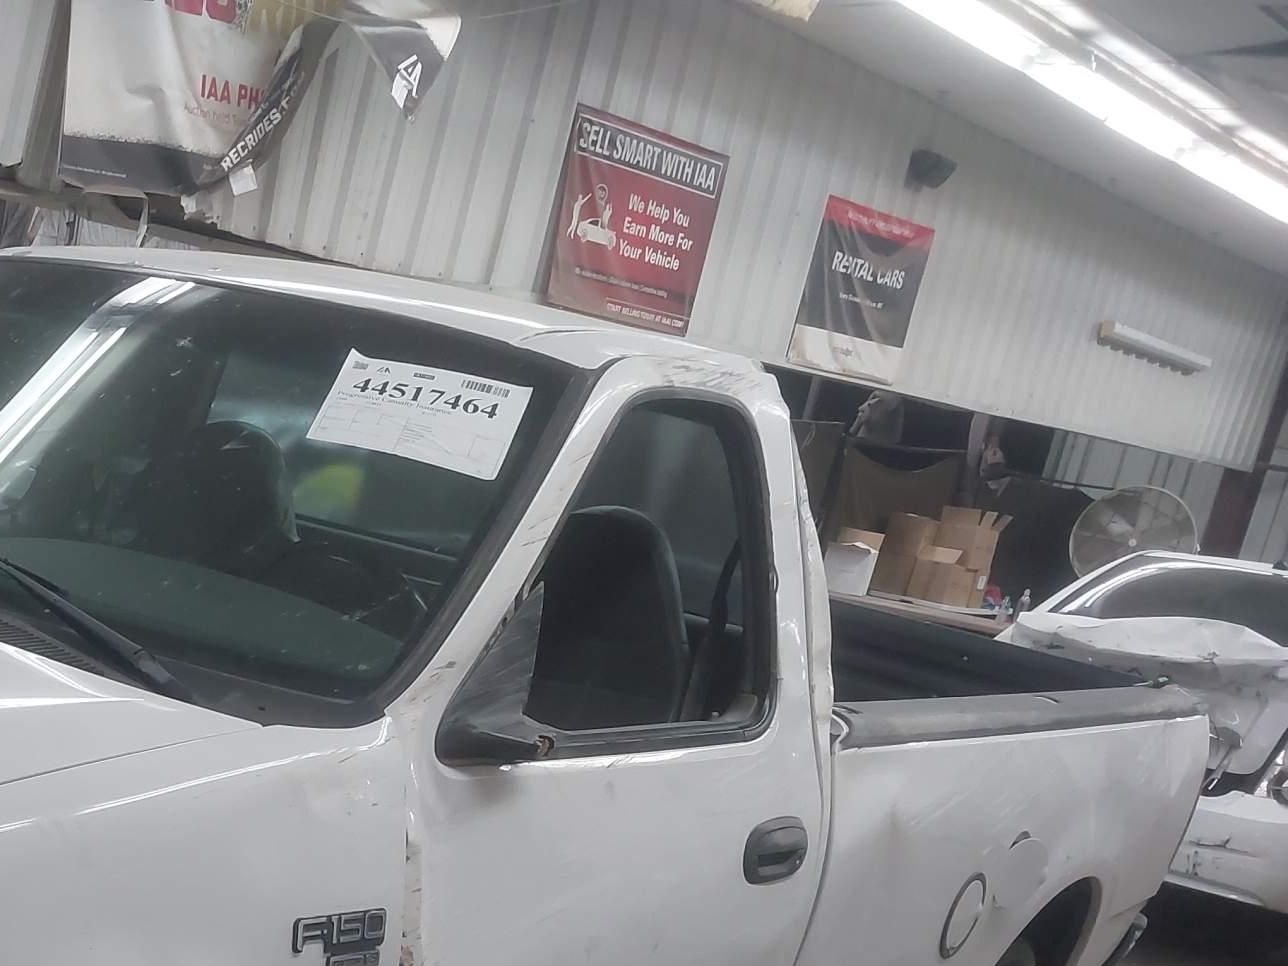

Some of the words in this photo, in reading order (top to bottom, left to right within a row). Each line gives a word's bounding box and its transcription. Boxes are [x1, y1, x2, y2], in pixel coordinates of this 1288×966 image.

[200, 74, 231, 105] IAA
[579, 121, 611, 156] SELL
[613, 134, 661, 171] SMART
[662, 149, 693, 184] WITH
[693, 161, 716, 192] IAA
[628, 193, 645, 213] We
[646, 199, 670, 224] Help
[672, 206, 690, 228] You
[623, 216, 647, 238] Earn
[649, 223, 675, 246] More
[677, 232, 694, 251] For
[618, 239, 643, 260] Your
[644, 246, 681, 271] Vehicle
[831, 250, 874, 282] RENTAL
[876, 269, 905, 289] CARS
[352, 377, 500, 420] 44517464
